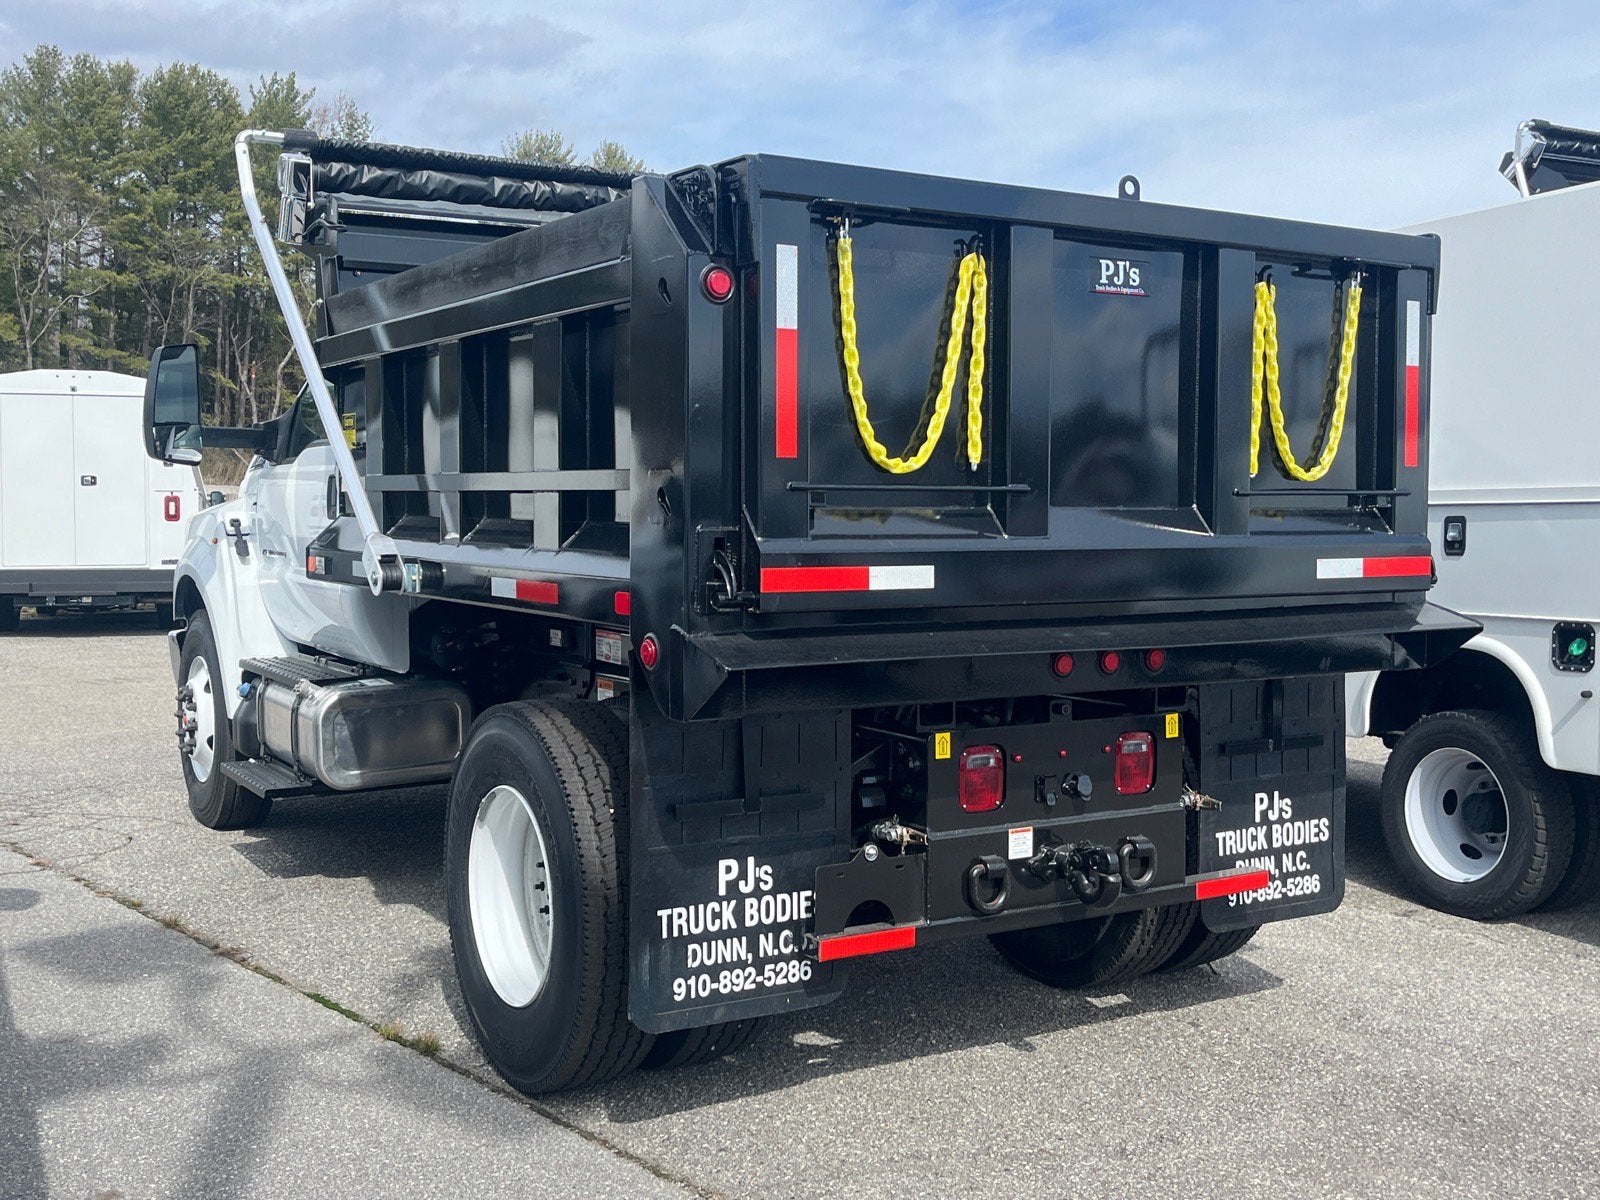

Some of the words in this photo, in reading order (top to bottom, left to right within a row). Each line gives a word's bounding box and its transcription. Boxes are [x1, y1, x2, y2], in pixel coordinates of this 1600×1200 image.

[1099, 259, 1140, 286] PJ's
[1215, 825, 1268, 856] TRUCK
[1271, 818, 1330, 848] BODIES
[1282, 850, 1311, 873] N.C.
[656, 900, 737, 939] TRUCK
[744, 890, 816, 927] BODIE
[687, 936, 753, 969] DUNN,
[759, 929, 799, 958] N.C.
[672, 960, 812, 1002] 910-892-5286
